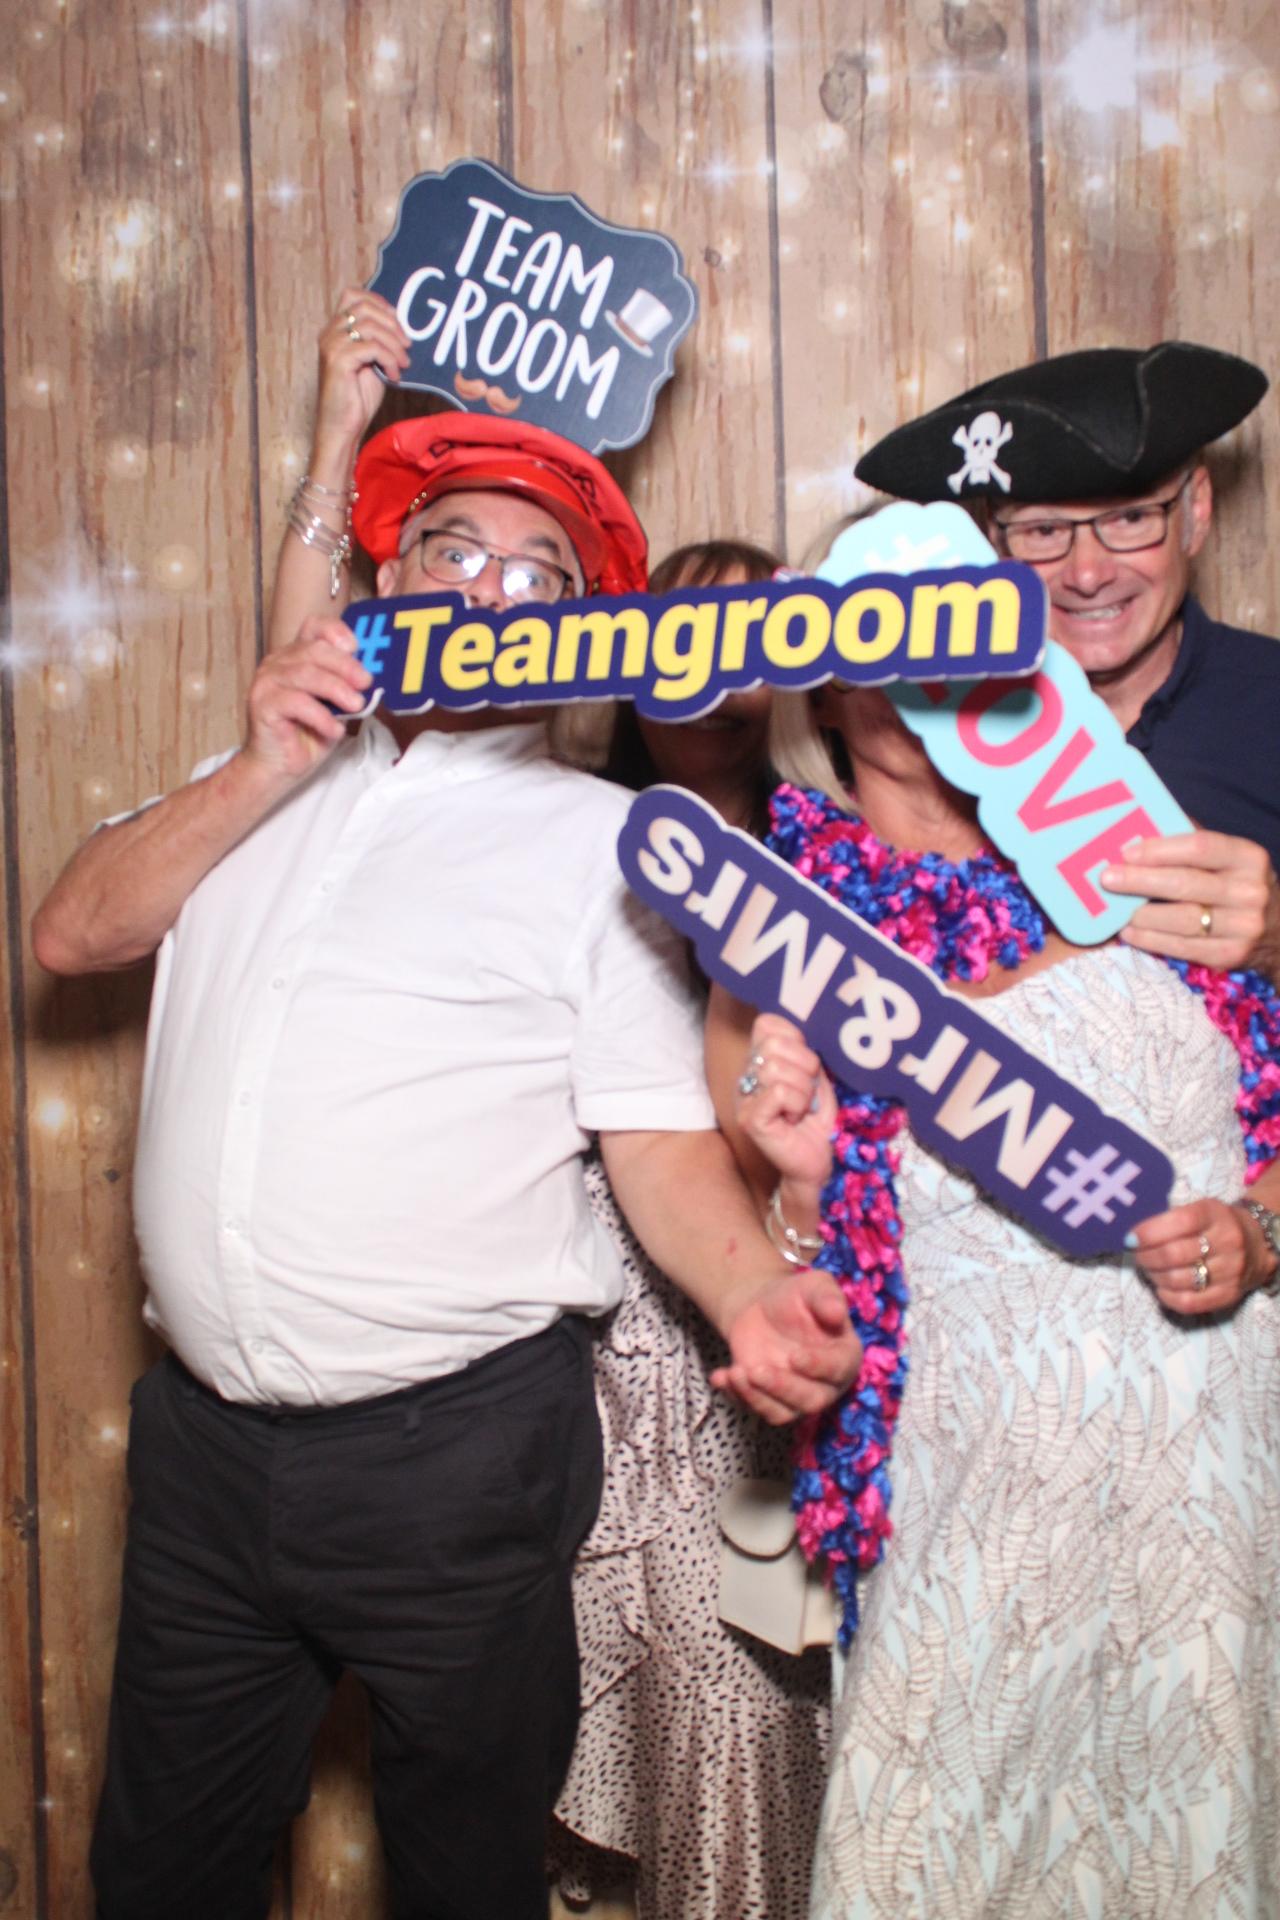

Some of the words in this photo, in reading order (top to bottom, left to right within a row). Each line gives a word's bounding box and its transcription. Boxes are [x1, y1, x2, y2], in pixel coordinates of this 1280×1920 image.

[455, 197, 614, 330] TEAM
[396, 266, 620, 420] GROOM
[354, 577, 1021, 701] #Teamgroom
[864, 533, 1163, 918] OVE
[637, 816, 1142, 1229] #Mr&Mrs
